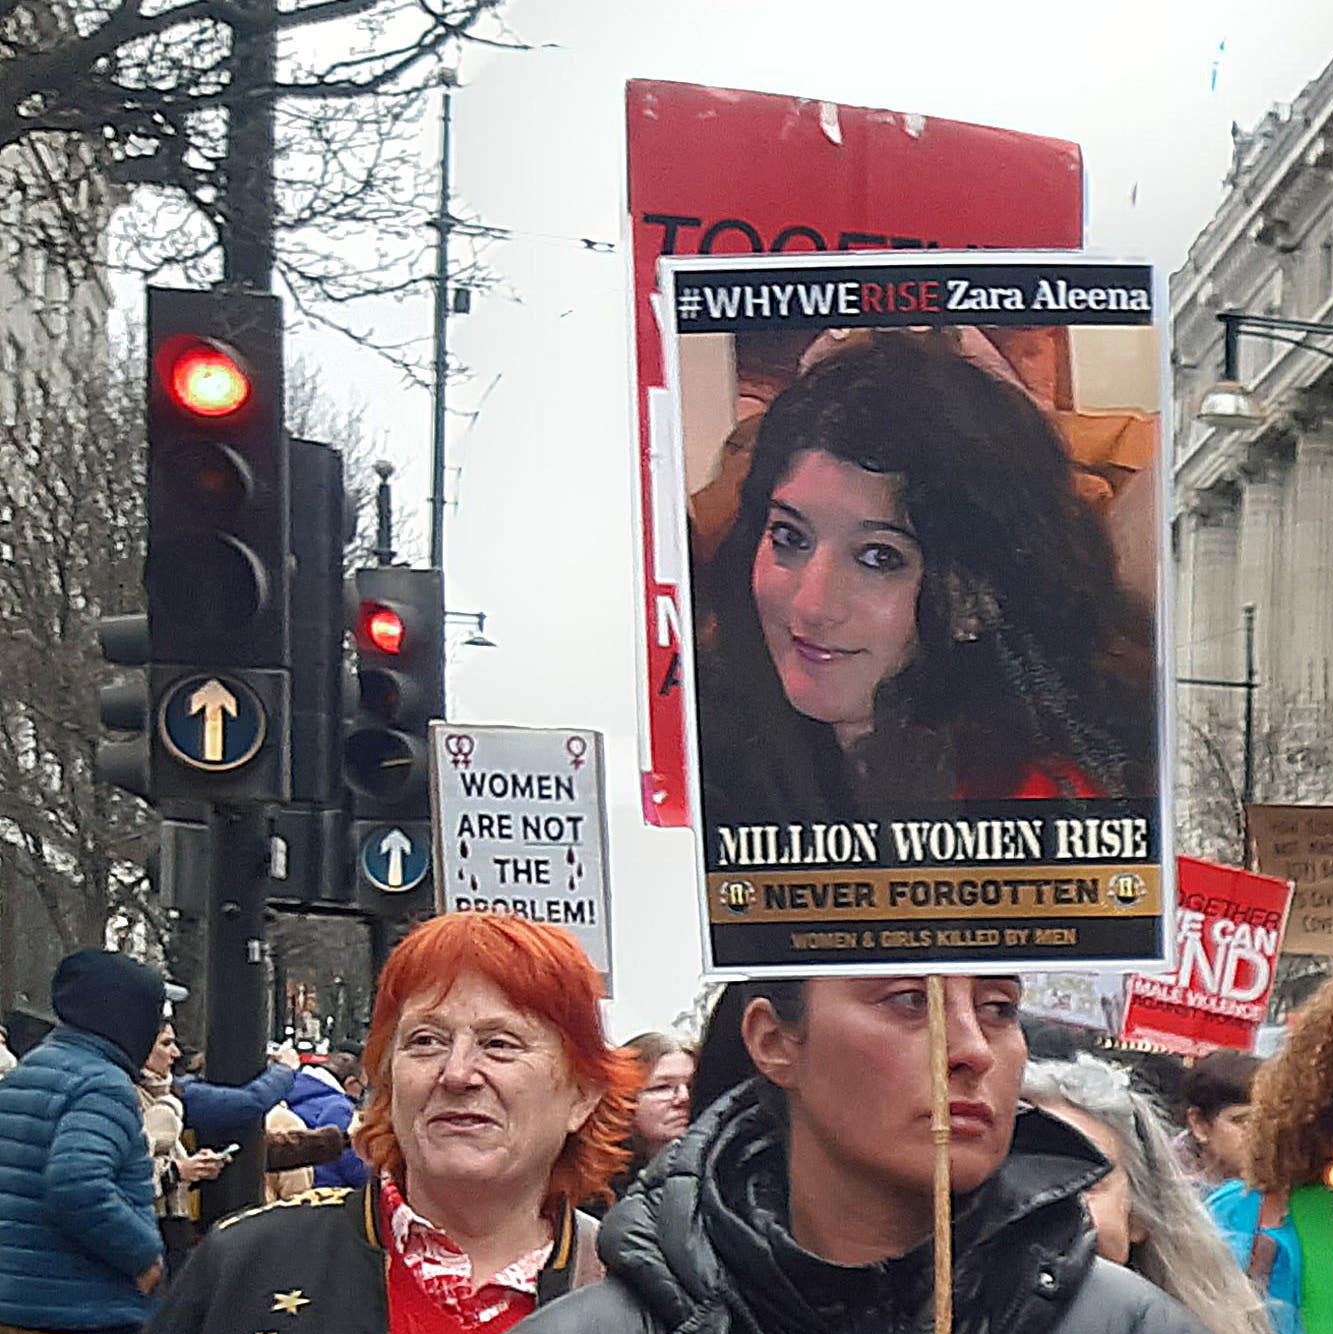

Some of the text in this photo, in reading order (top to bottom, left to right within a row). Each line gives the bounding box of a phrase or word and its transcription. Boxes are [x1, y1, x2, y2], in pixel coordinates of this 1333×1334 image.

[678, 279, 1151, 319] #WHYWERISE Zara Aleena
[461, 773, 575, 800] WOMEN
[457, 814, 584, 842] ARE NOT
[718, 818, 1148, 866] MILLION WOMEN RISE
[494, 859, 550, 884] THE
[763, 877, 1099, 910] NEVER FORGOTTEN
[1179, 892, 1281, 931] GETHER
[791, 928, 1077, 949] WOMEN & GIRLS KILLED BY MEN
[1212, 918, 1278, 956] CAN
